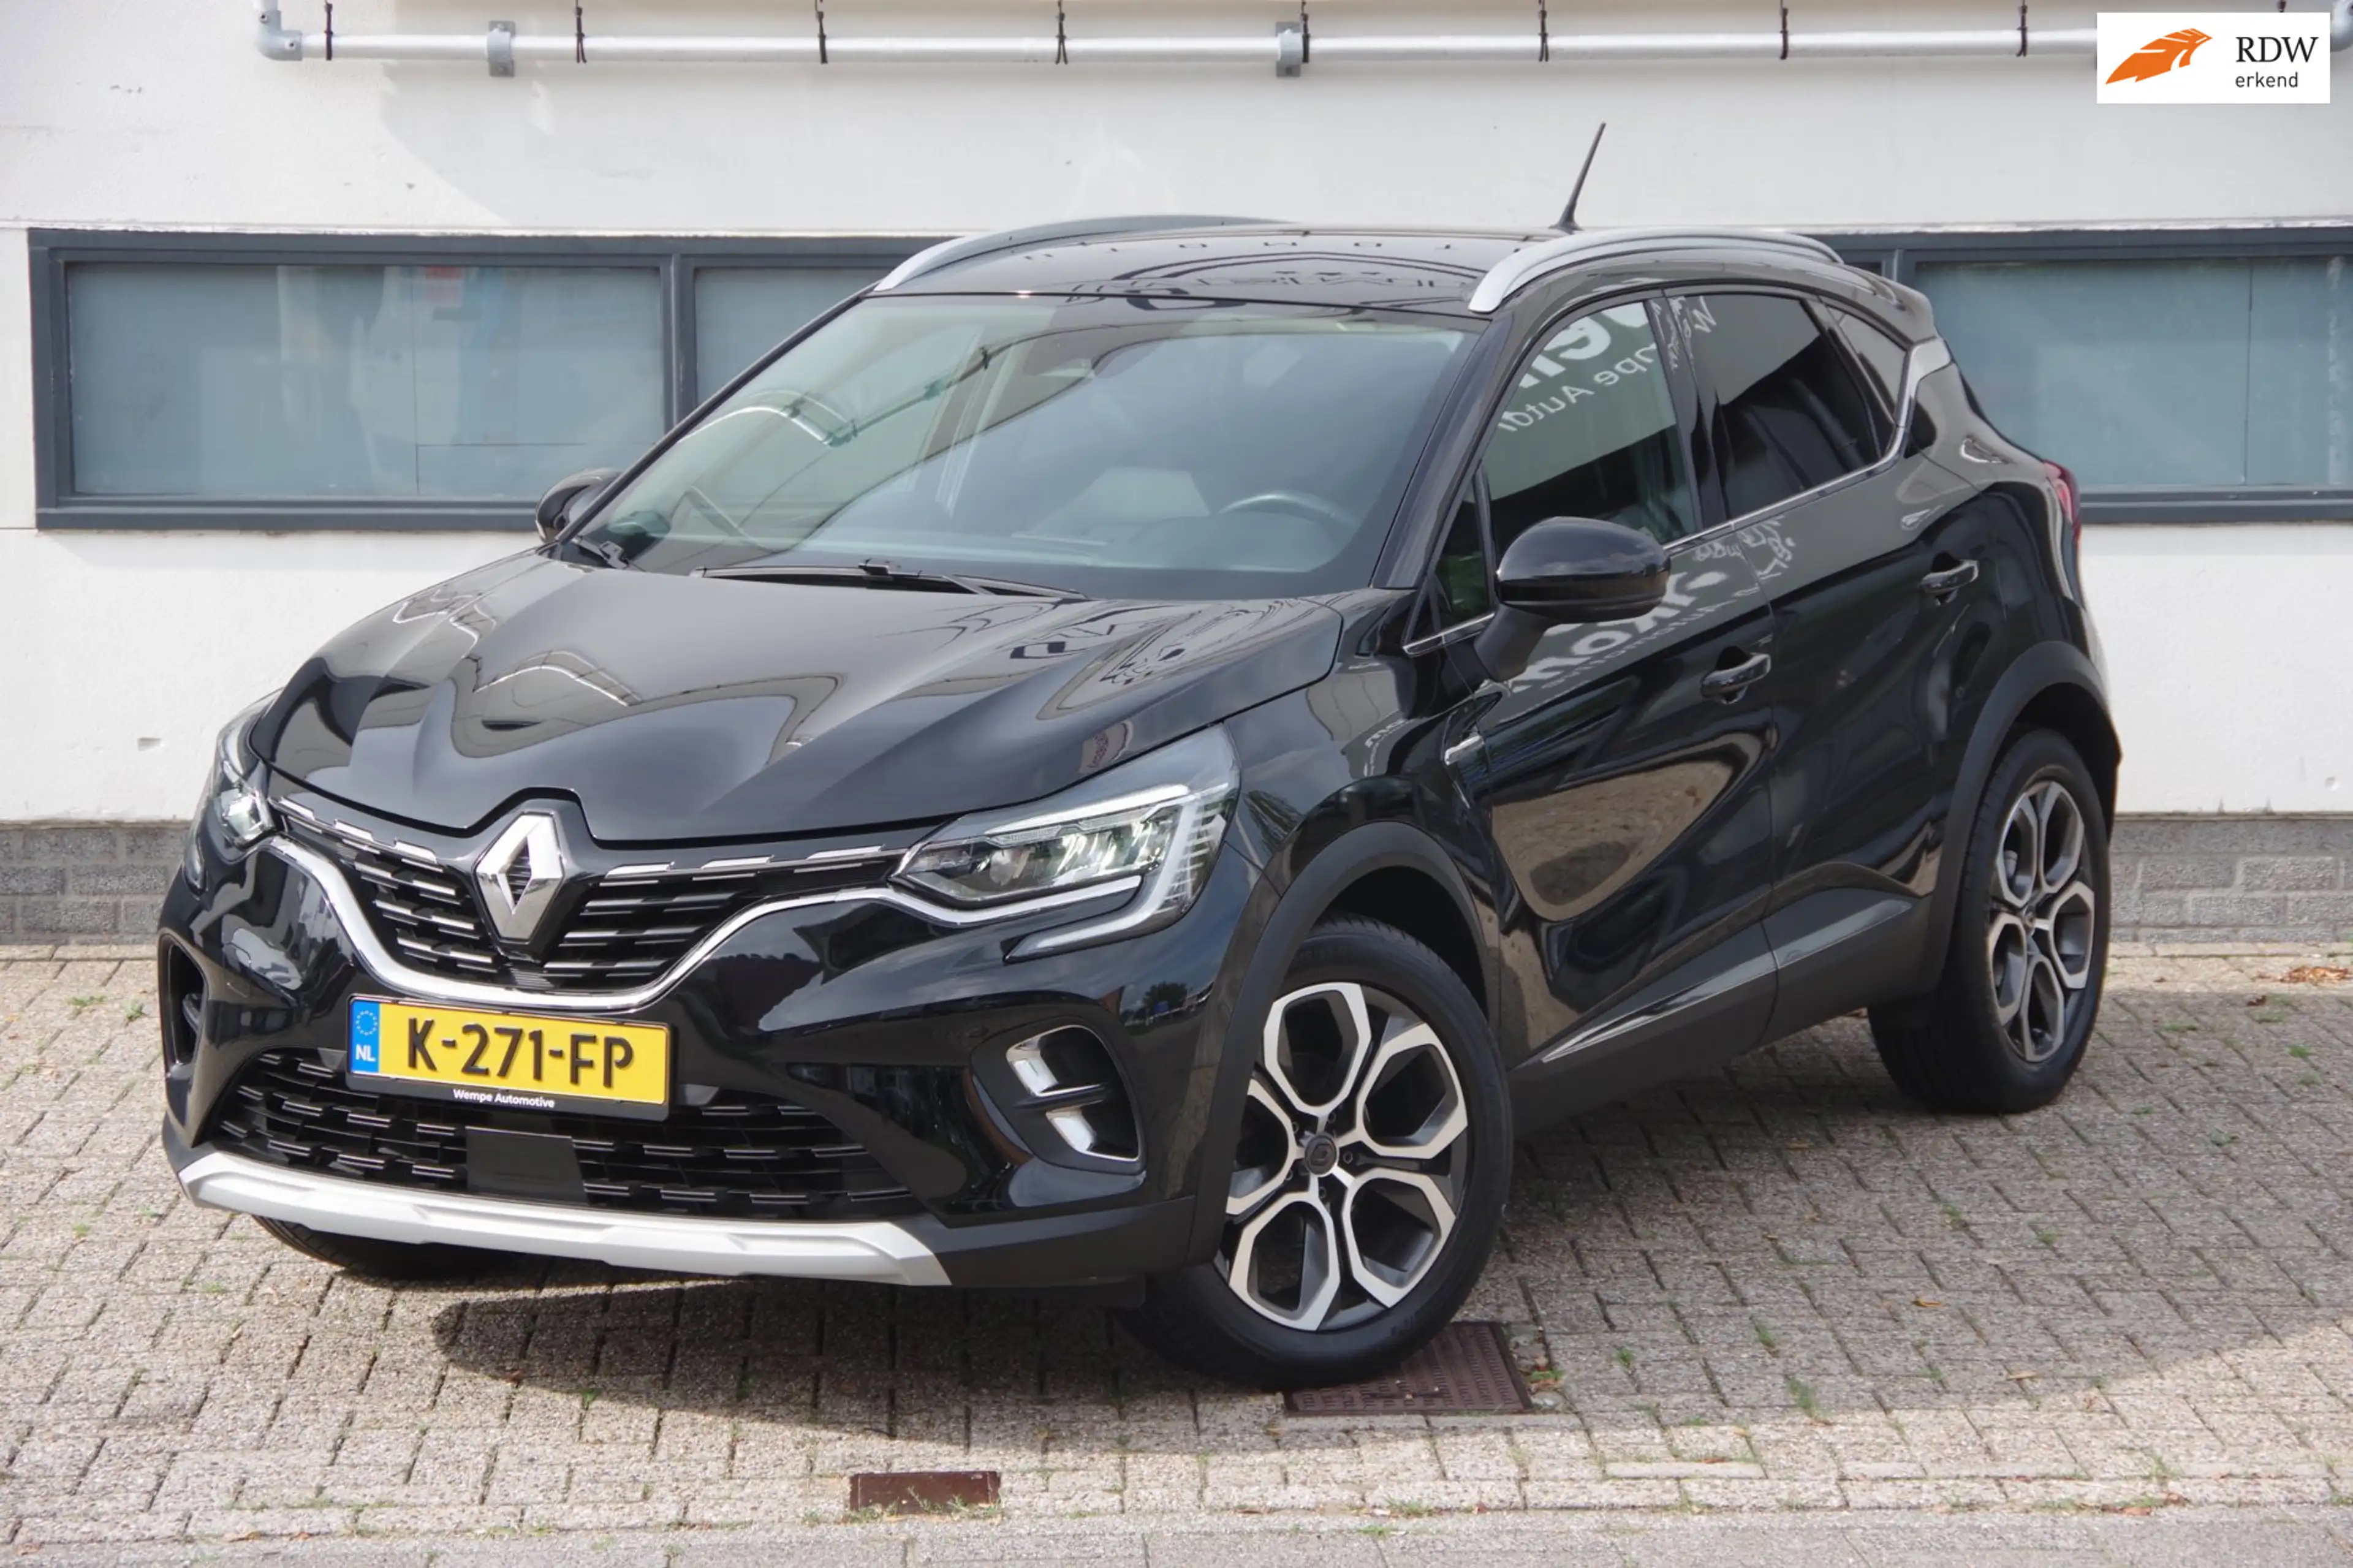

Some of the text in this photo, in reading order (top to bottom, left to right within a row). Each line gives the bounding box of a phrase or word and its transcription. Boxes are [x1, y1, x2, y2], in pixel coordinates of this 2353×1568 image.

[355, 1043, 376, 1062] NL
[407, 1017, 634, 1088] K-271-FP
[453, 1089, 555, 1108] Wempe Automotive
